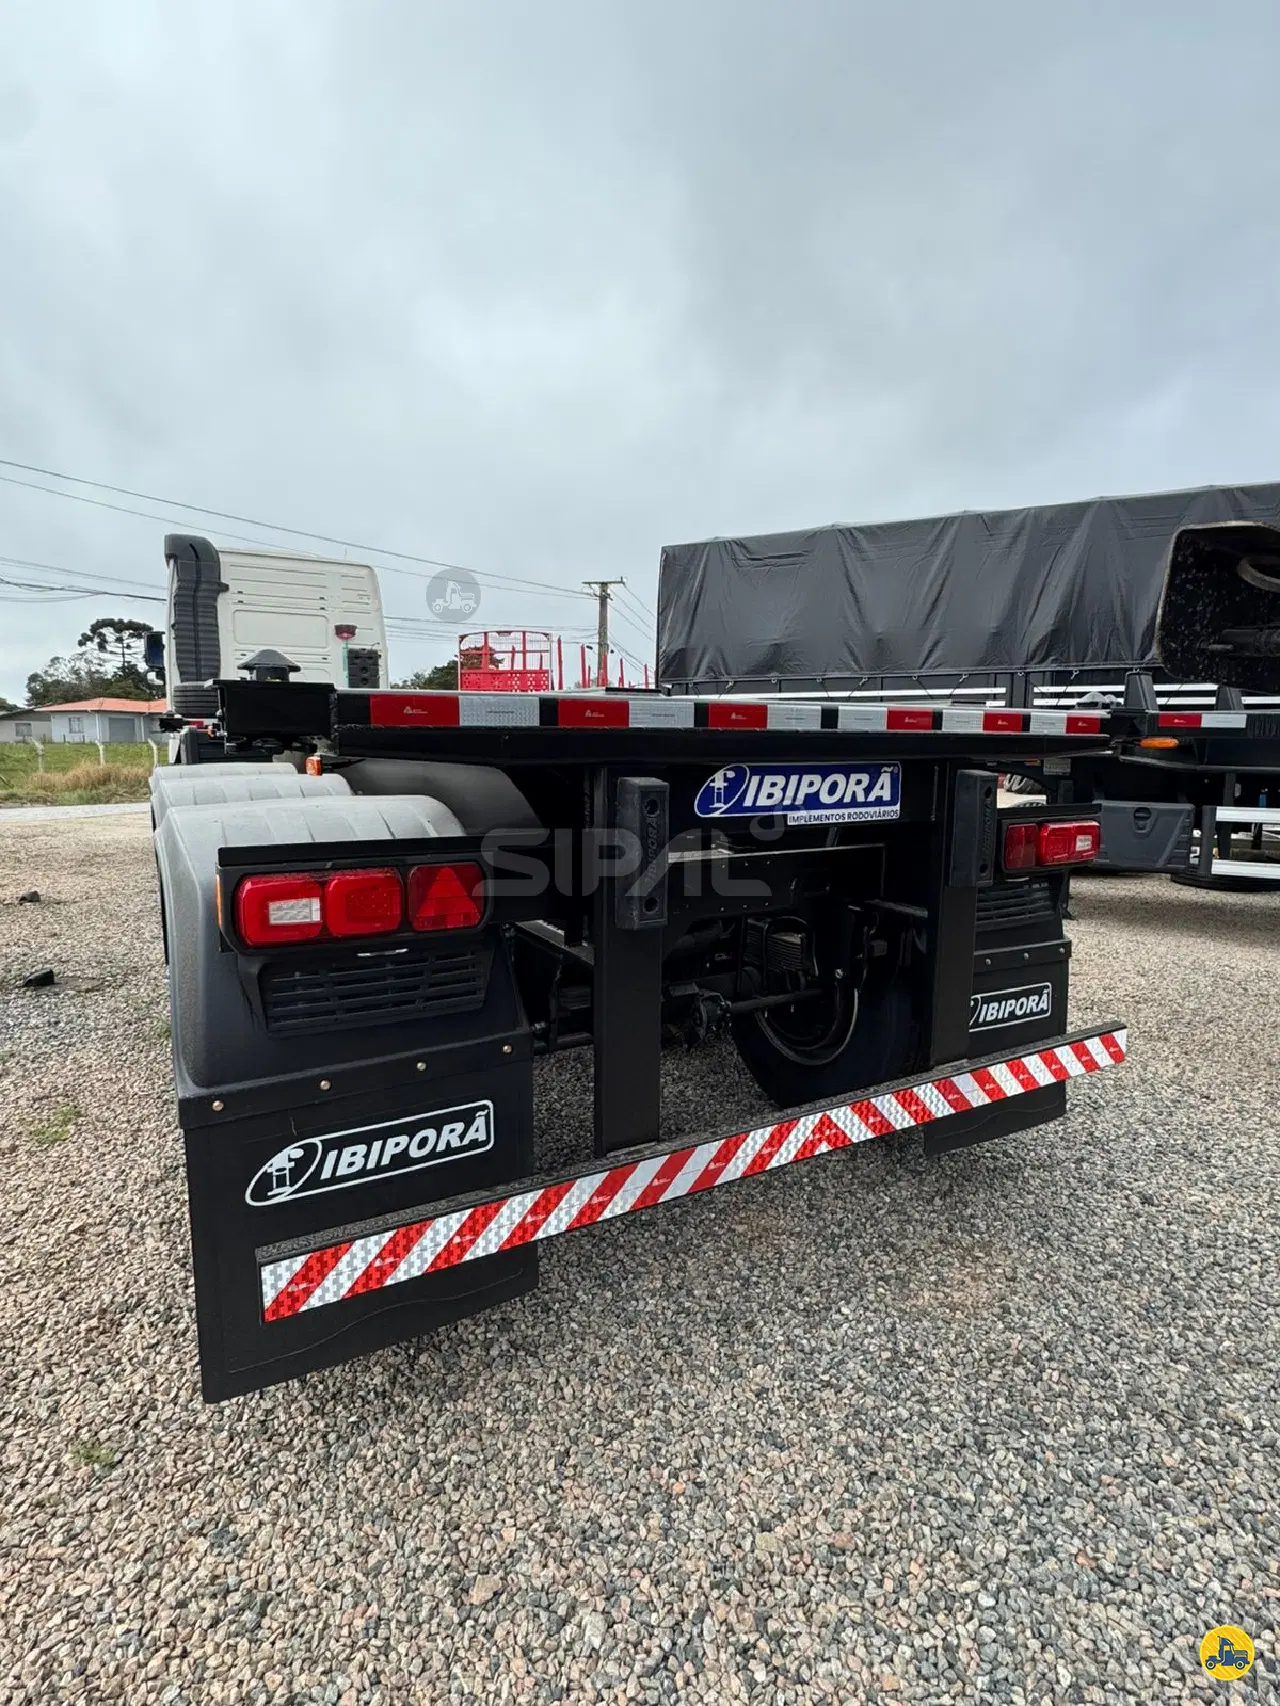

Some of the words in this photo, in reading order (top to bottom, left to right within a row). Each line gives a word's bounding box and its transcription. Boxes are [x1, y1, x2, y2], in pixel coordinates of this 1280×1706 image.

[743, 766, 893, 807] IBIPORÃ
[789, 812, 846, 824] IMPLEMENTOS
[847, 808, 899, 821] RODOVIÁRIOS
[320, 1109, 489, 1180] IBIPORÃ
